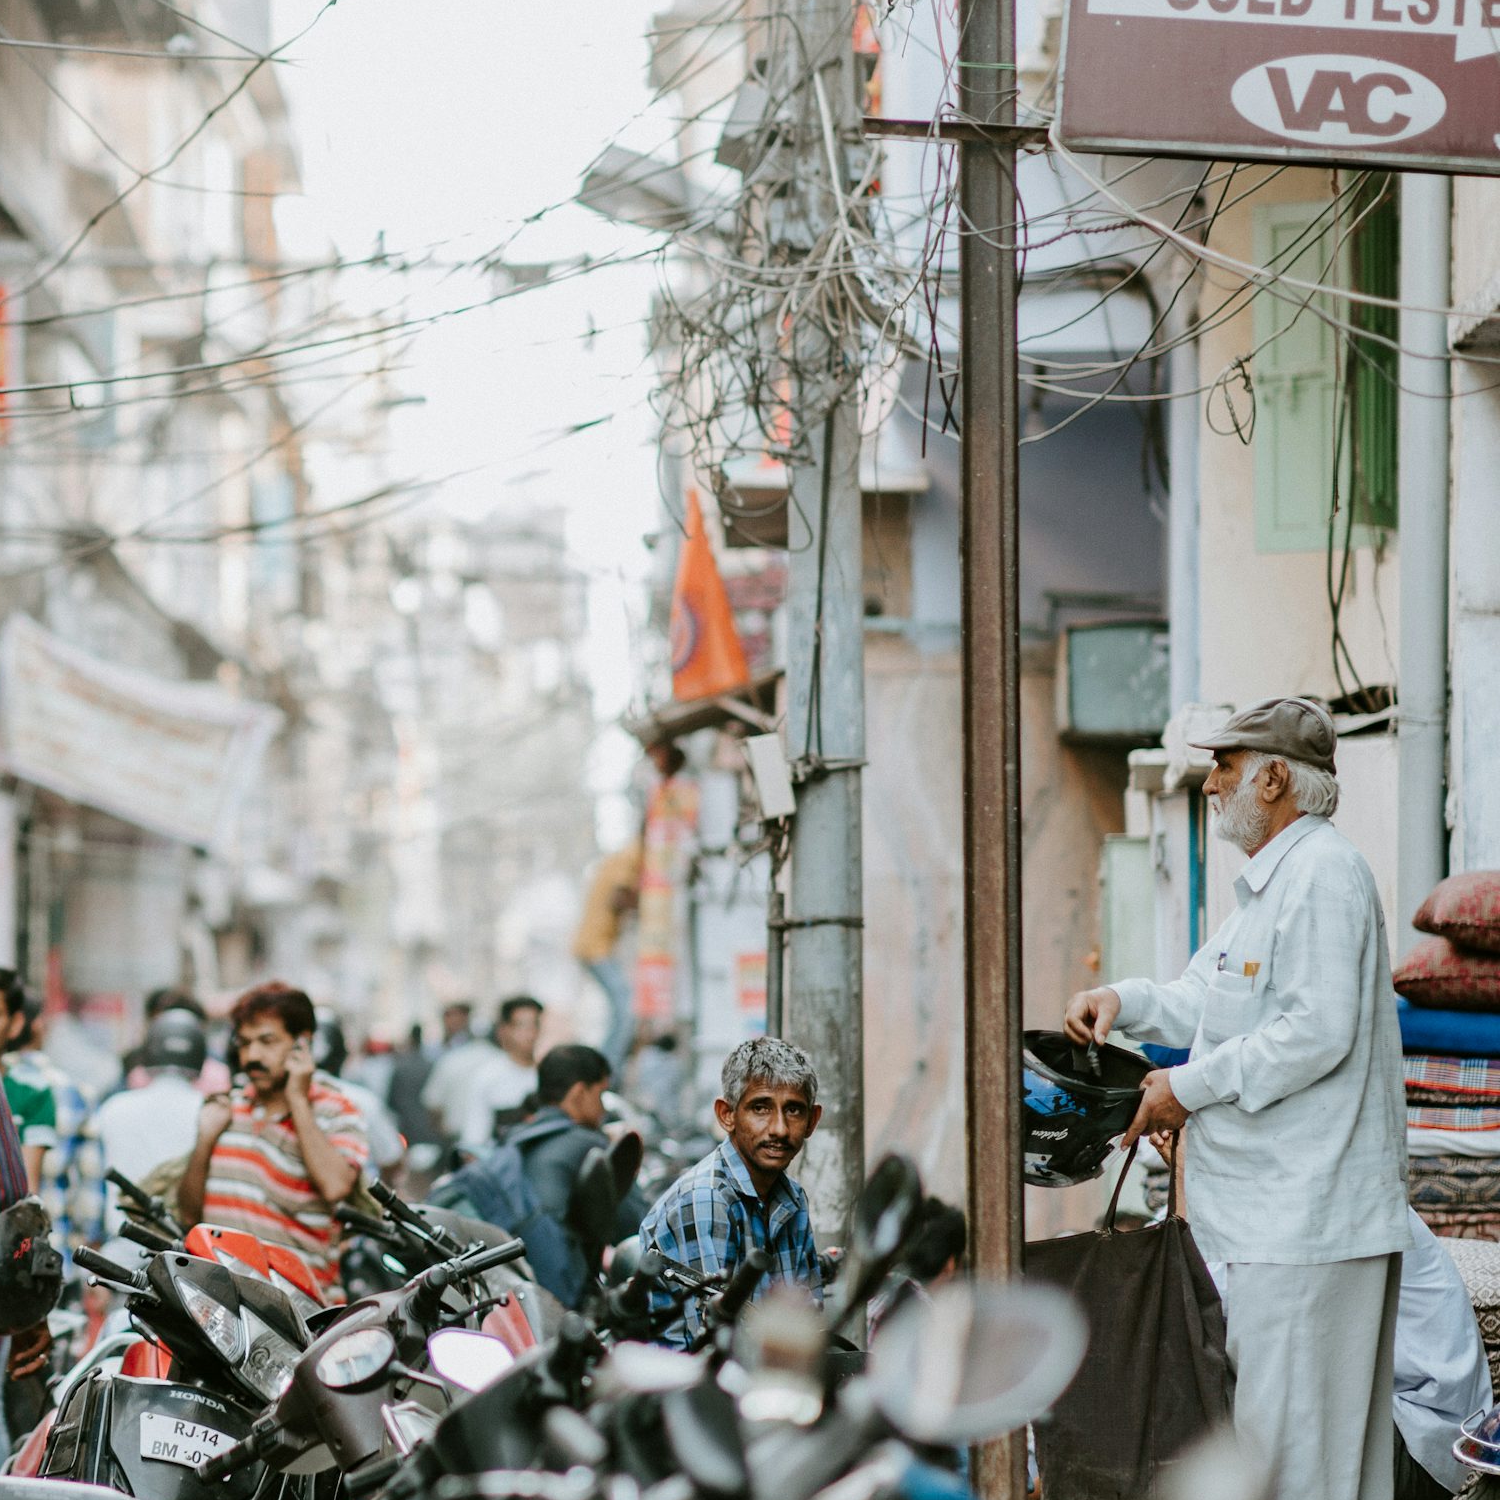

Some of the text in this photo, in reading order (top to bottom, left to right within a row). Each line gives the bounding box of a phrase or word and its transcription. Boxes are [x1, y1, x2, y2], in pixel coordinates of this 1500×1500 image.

[1265, 66, 1412, 135] VAC
[1031, 1128, 1069, 1141] Golden
[169, 1390, 227, 1413] HONDA
[151, 1440, 179, 1458] BM
